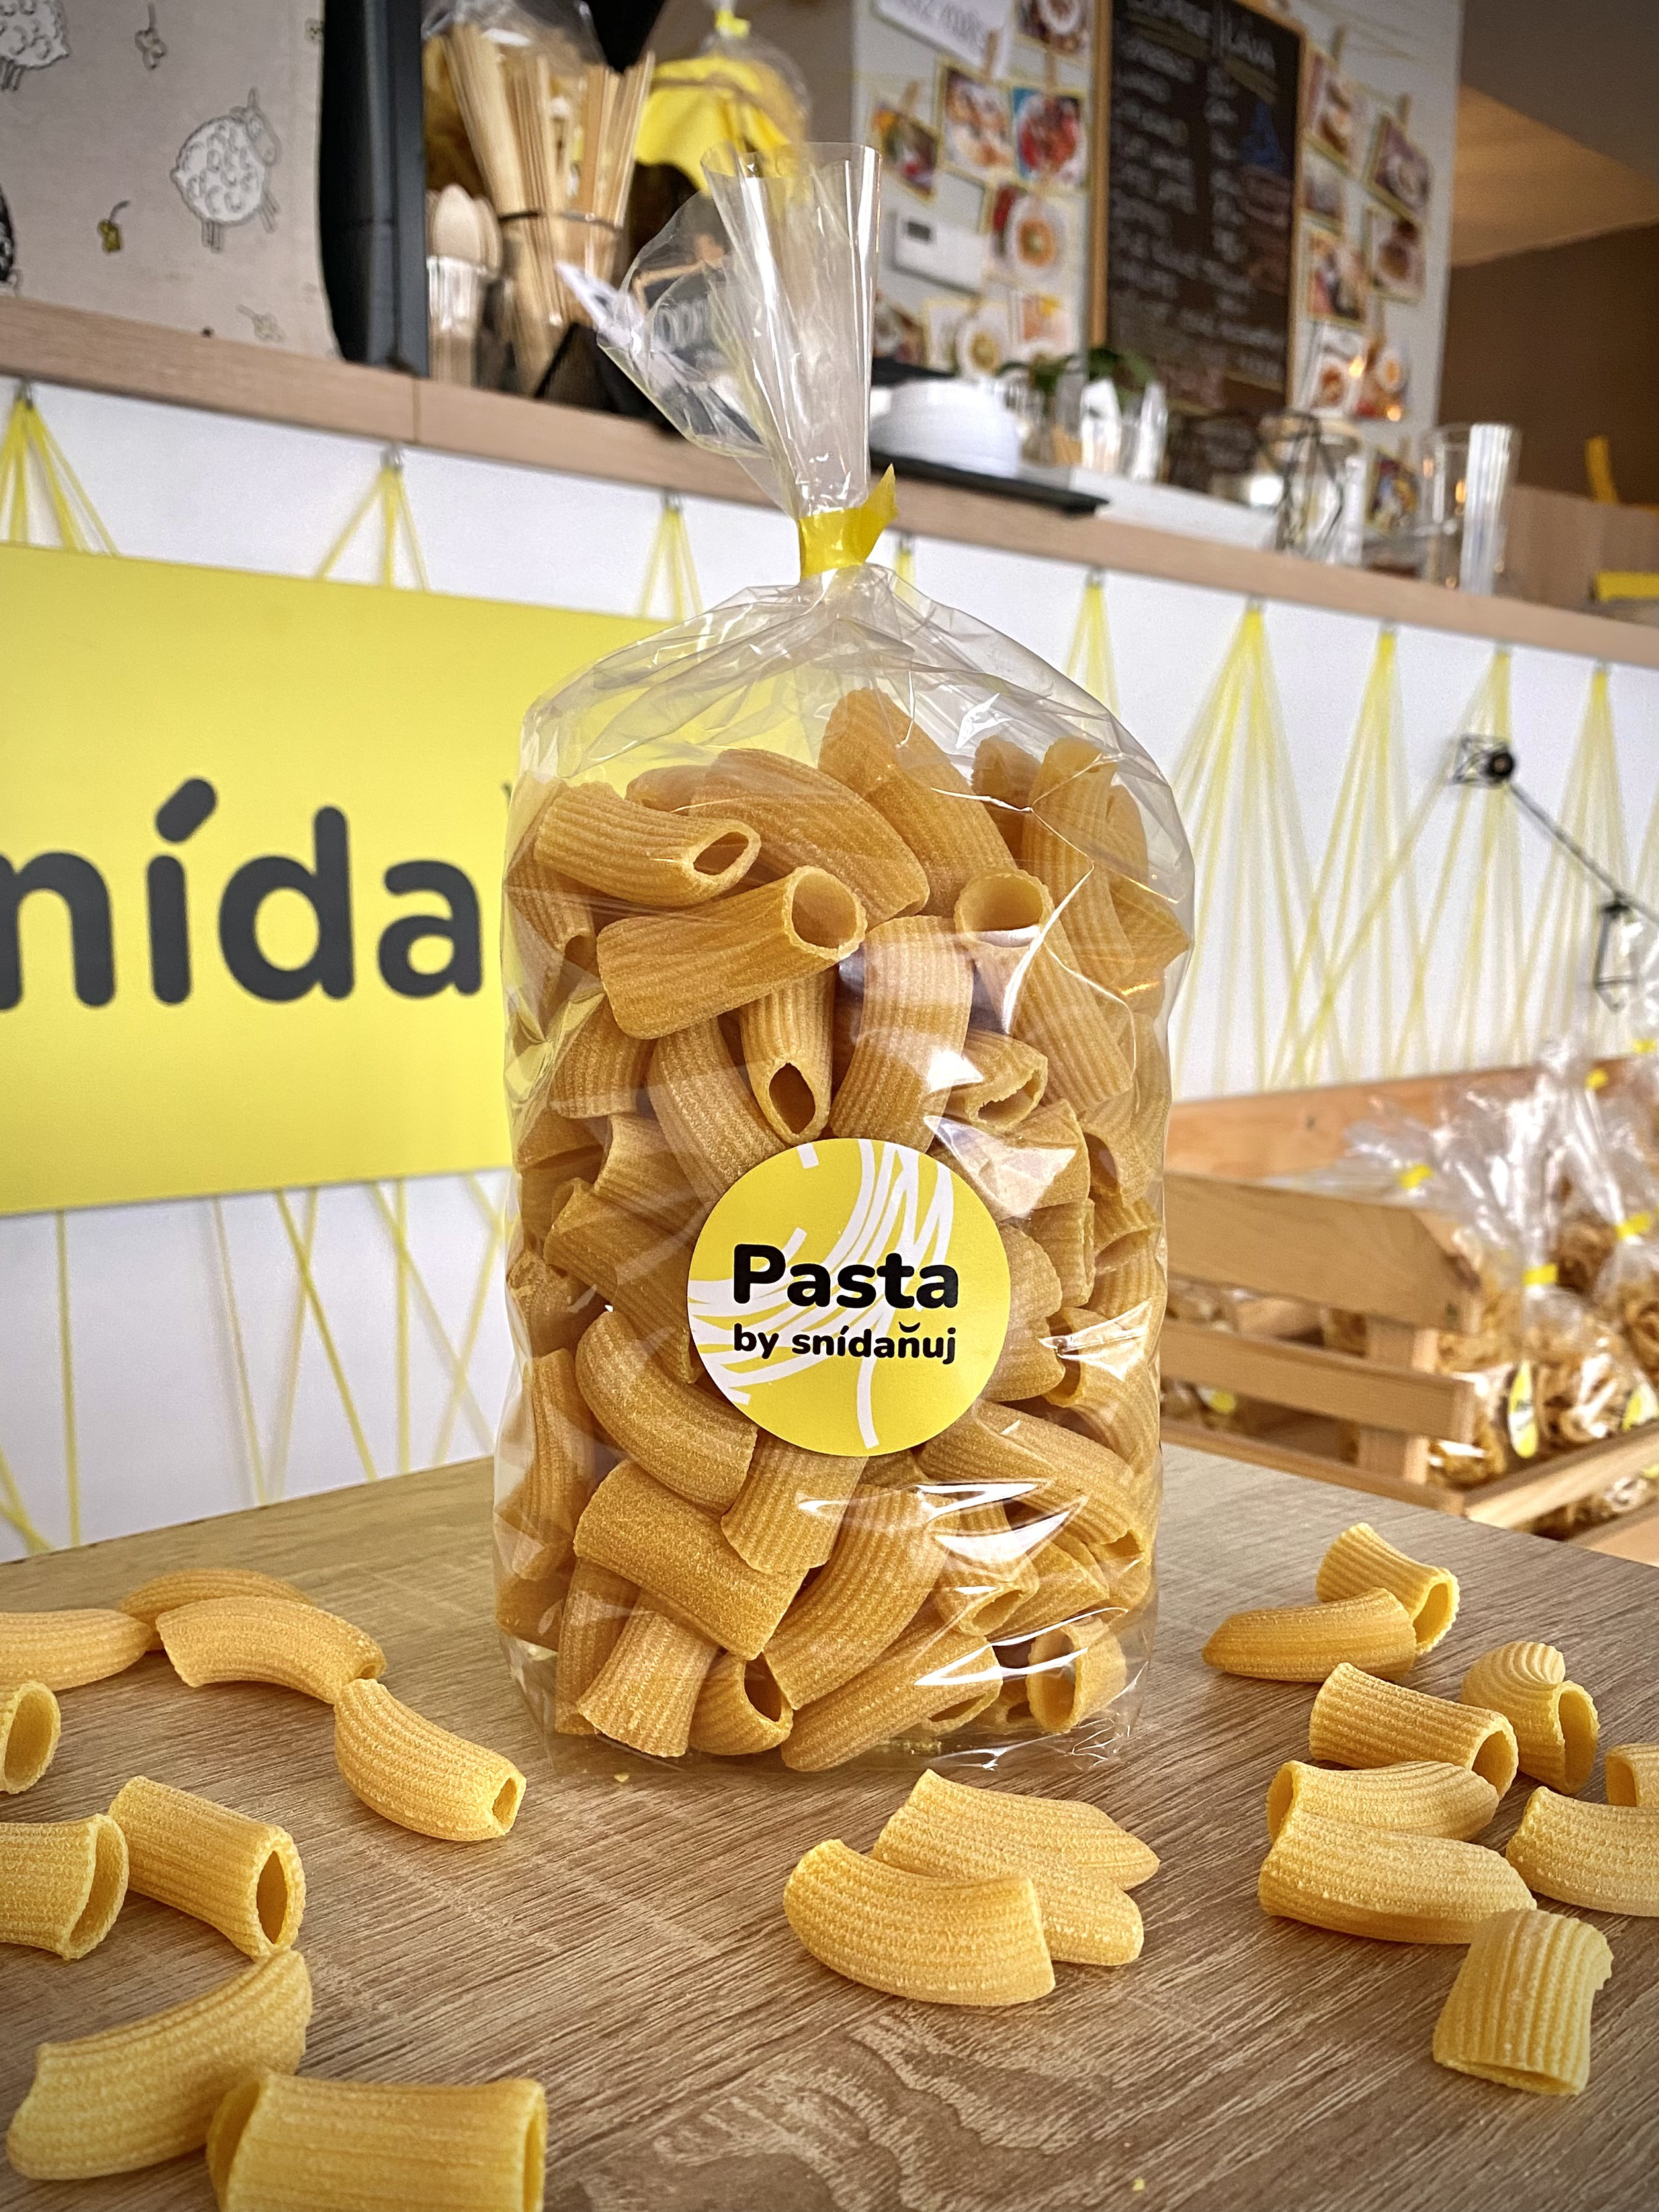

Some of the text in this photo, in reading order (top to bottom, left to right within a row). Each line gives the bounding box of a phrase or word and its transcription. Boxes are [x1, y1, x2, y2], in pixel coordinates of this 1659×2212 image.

[0, 777, 511, 1012] nída
[733, 1243, 959, 1310] Pasta
[733, 1322, 780, 1360] by
